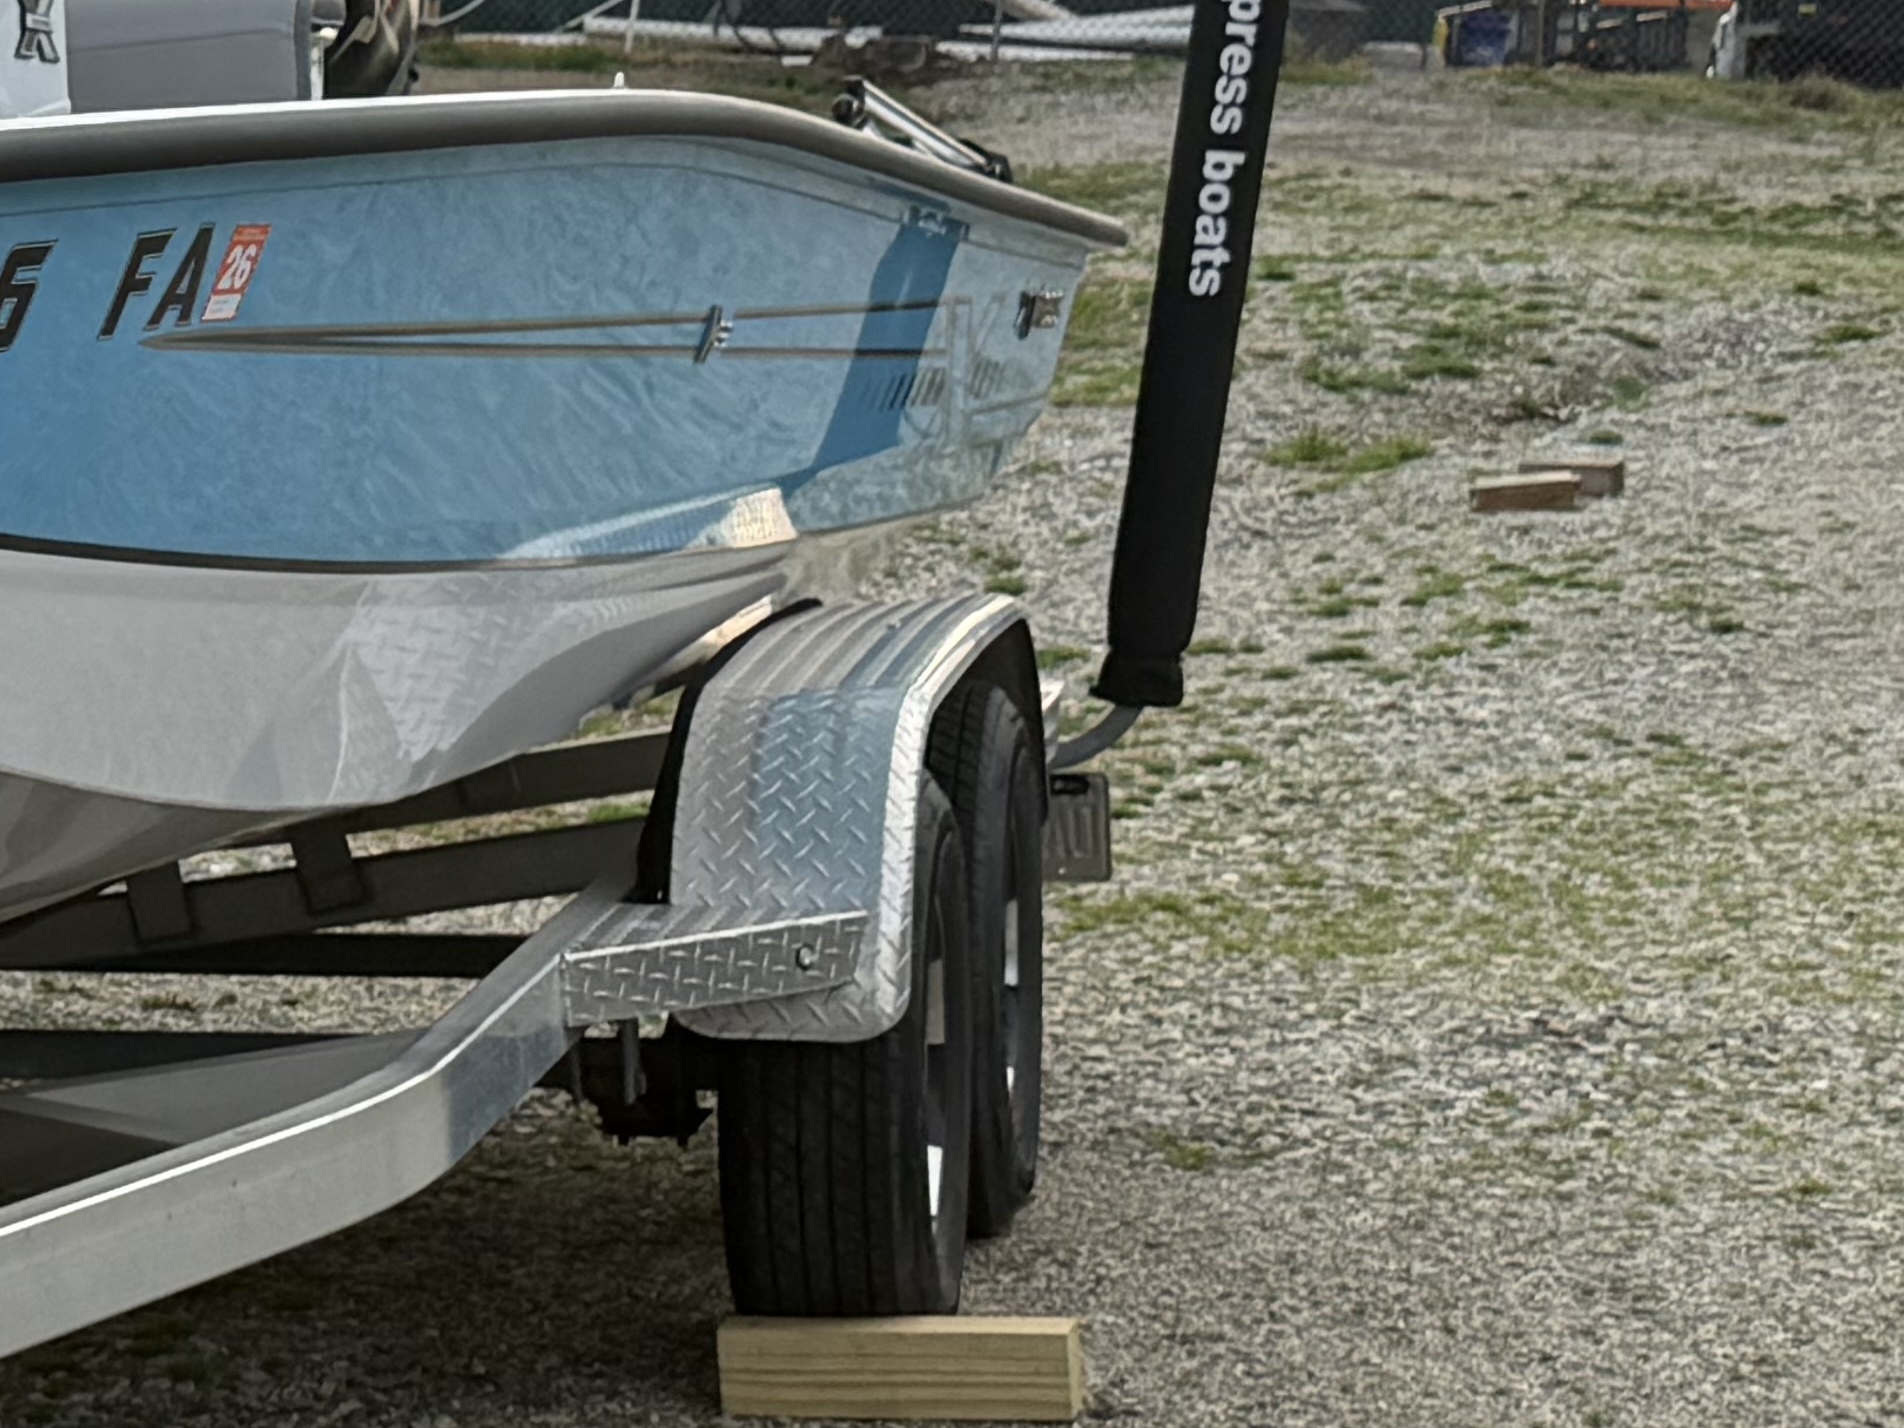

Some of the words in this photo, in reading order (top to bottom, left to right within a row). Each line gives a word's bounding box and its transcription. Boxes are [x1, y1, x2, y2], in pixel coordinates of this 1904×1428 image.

[98, 222, 216, 341] FA
[216, 243, 258, 290] 26
[1189, 148, 1248, 299] boats
